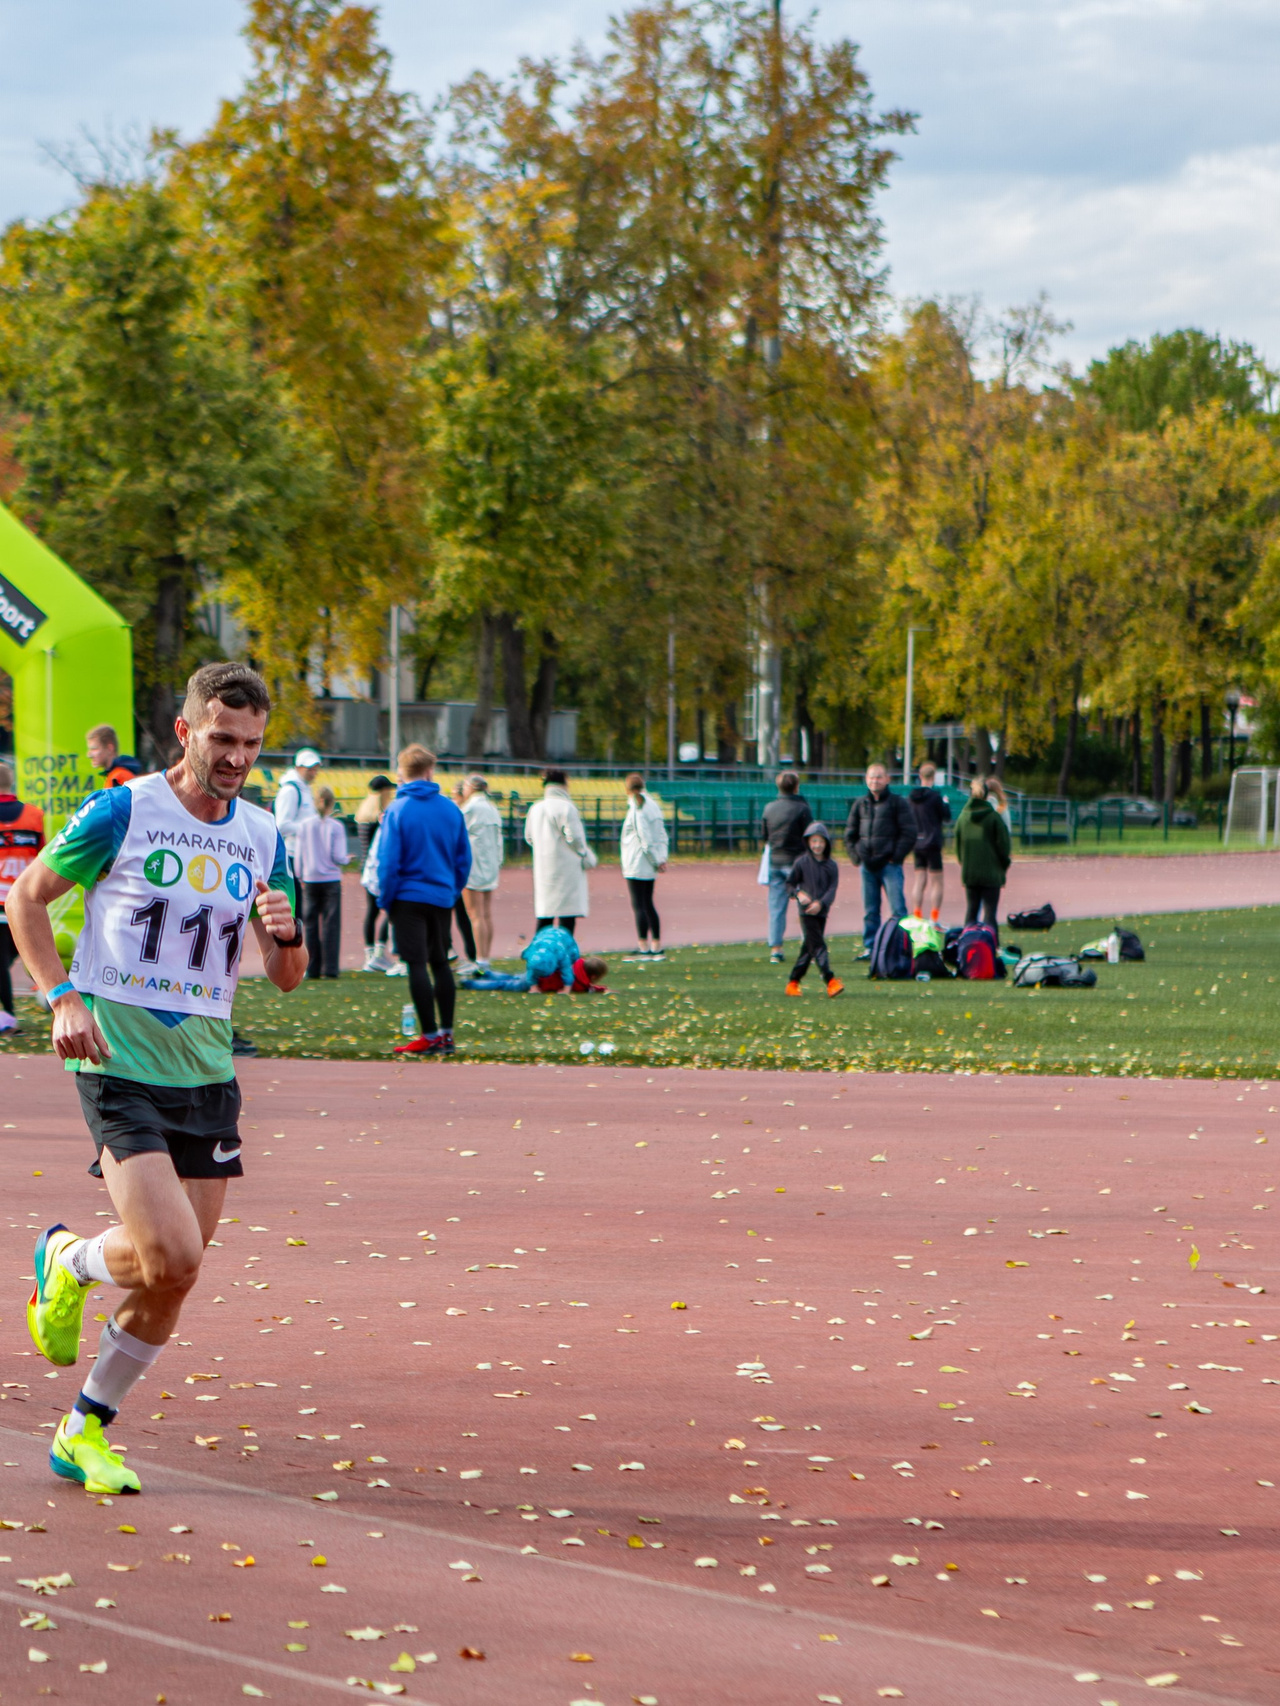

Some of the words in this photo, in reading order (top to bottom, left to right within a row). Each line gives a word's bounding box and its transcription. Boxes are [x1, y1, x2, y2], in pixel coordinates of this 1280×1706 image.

[33, 796, 84, 816] ИЗН
[146, 829, 256, 863] VMARAFONE
[130, 896, 245, 978] 111
